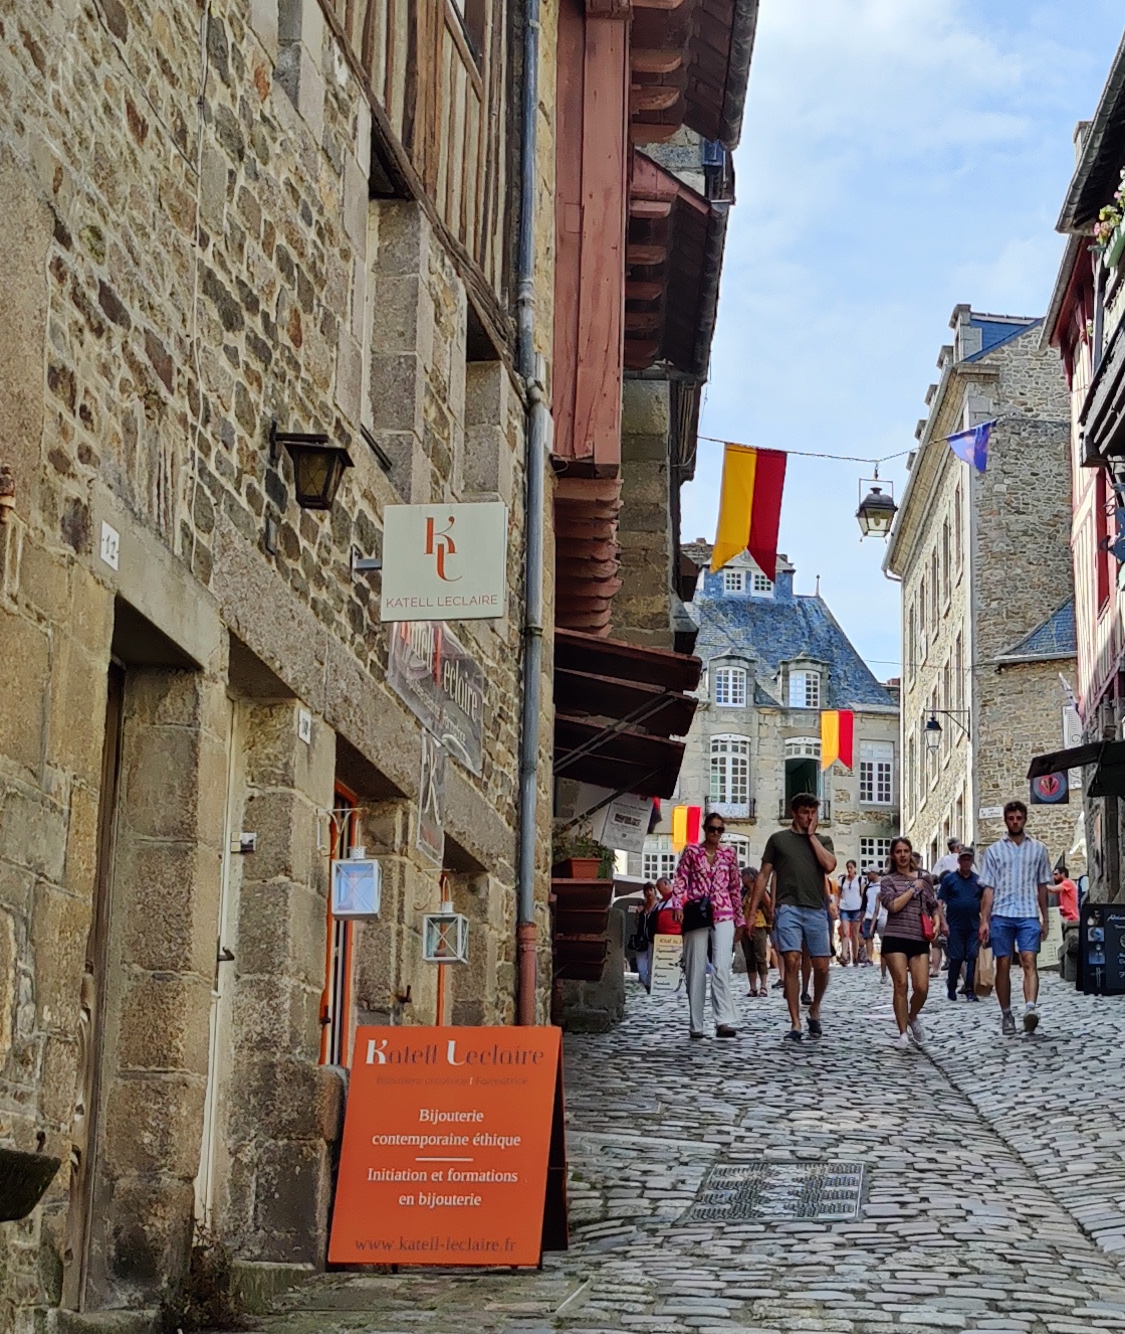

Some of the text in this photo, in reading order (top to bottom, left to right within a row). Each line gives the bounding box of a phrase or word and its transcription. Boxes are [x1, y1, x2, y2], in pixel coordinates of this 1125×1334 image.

[386, 594, 498, 608] KATELL LECLAIRE
[365, 1039, 545, 1066] Katell Leclaire
[419, 1109, 484, 1125] Bijouterie
[371, 1132, 521, 1149] contemporaine éthique
[367, 1168, 518, 1183] Initiation et formations
[398, 1192, 482, 1209] en bijouterie
